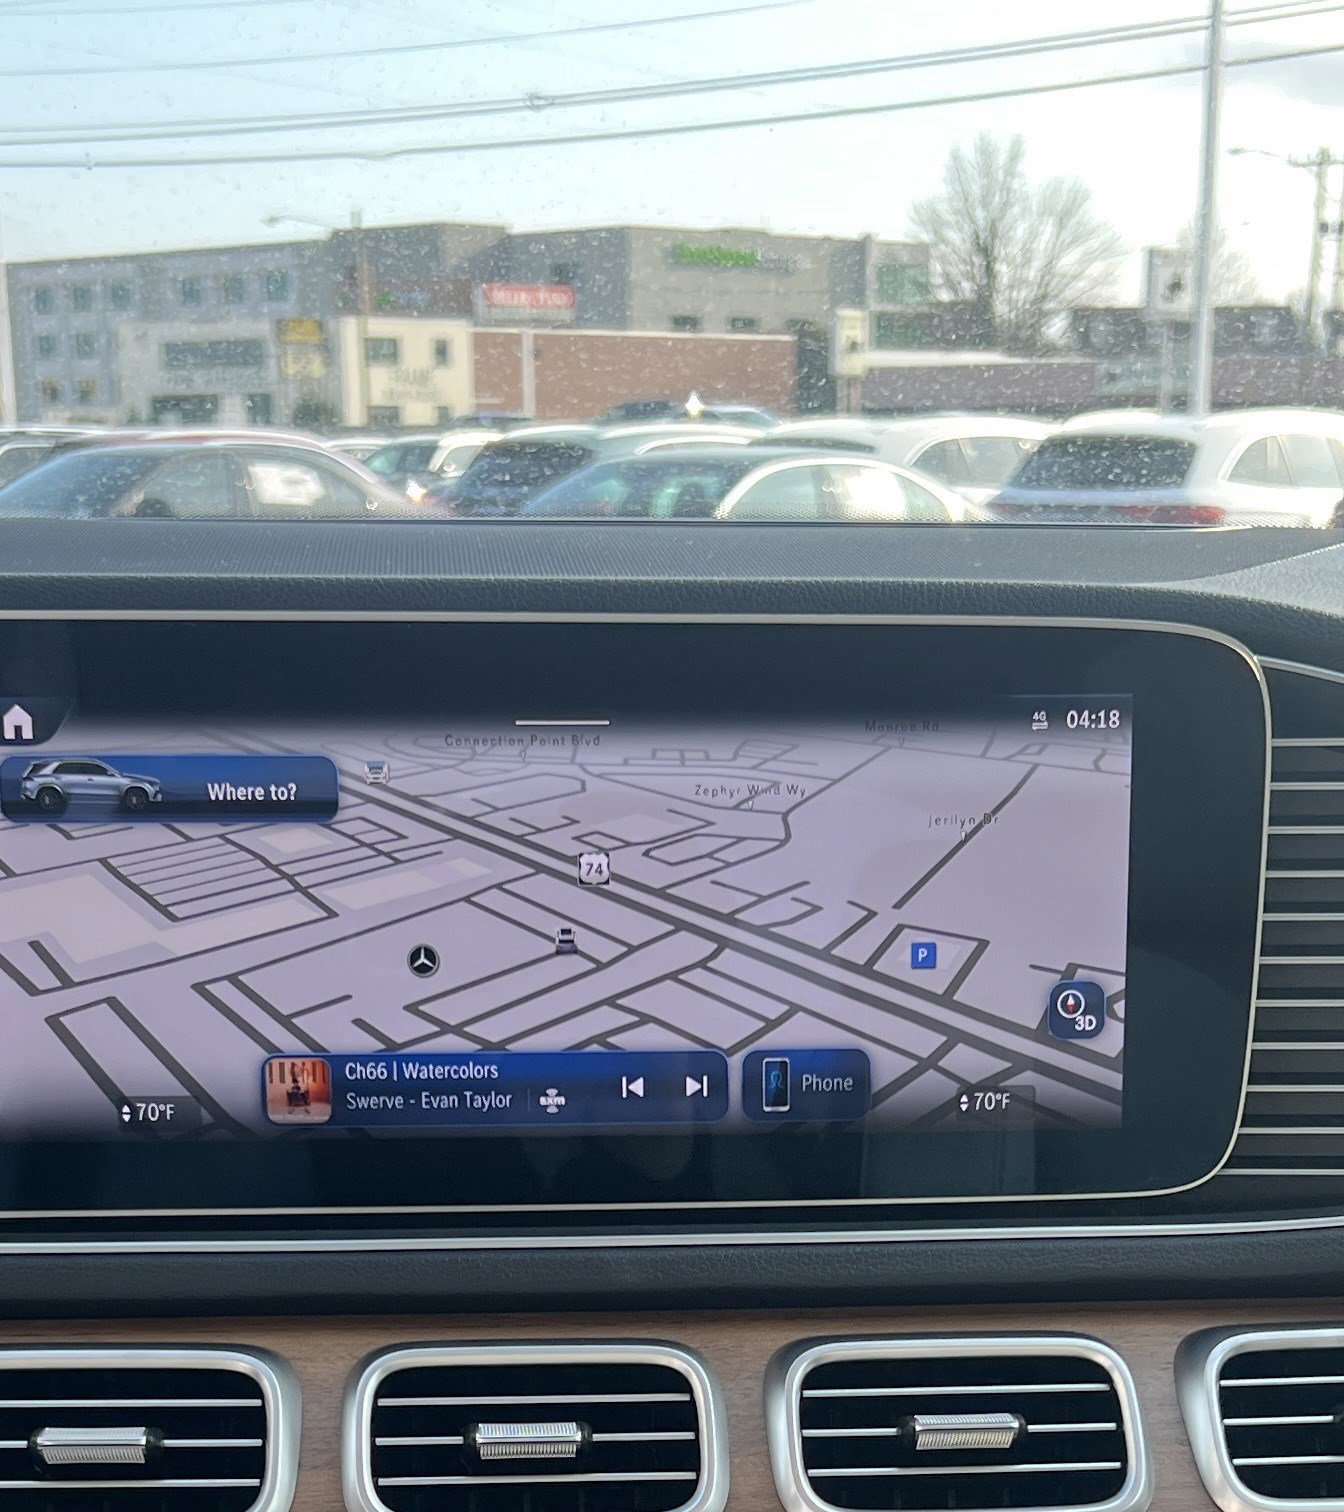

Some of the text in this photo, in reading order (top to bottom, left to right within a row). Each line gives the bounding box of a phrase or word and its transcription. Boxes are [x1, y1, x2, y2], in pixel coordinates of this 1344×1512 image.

[1032, 709, 1120, 729] 4G 04:18
[444, 734, 601, 747] Connection Point Blvd
[206, 782, 298, 802] Where to?
[693, 784, 741, 798] Zephyr
[785, 784, 807, 799] Wy
[927, 812, 999, 829] Jerilyn Dr
[584, 862, 604, 877] 74
[1074, 1014, 1097, 1031] 3D
[344, 1061, 387, 1080] Ch66
[403, 1060, 499, 1080] Watercolors
[802, 1074, 853, 1092] Phone
[346, 1092, 404, 1111] Swerve
[421, 1091, 458, 1110] Evan
[465, 1090, 512, 1112] Taylor
[974, 1092, 1011, 1112] 70°F
[136, 1102, 175, 1122] 70°F
